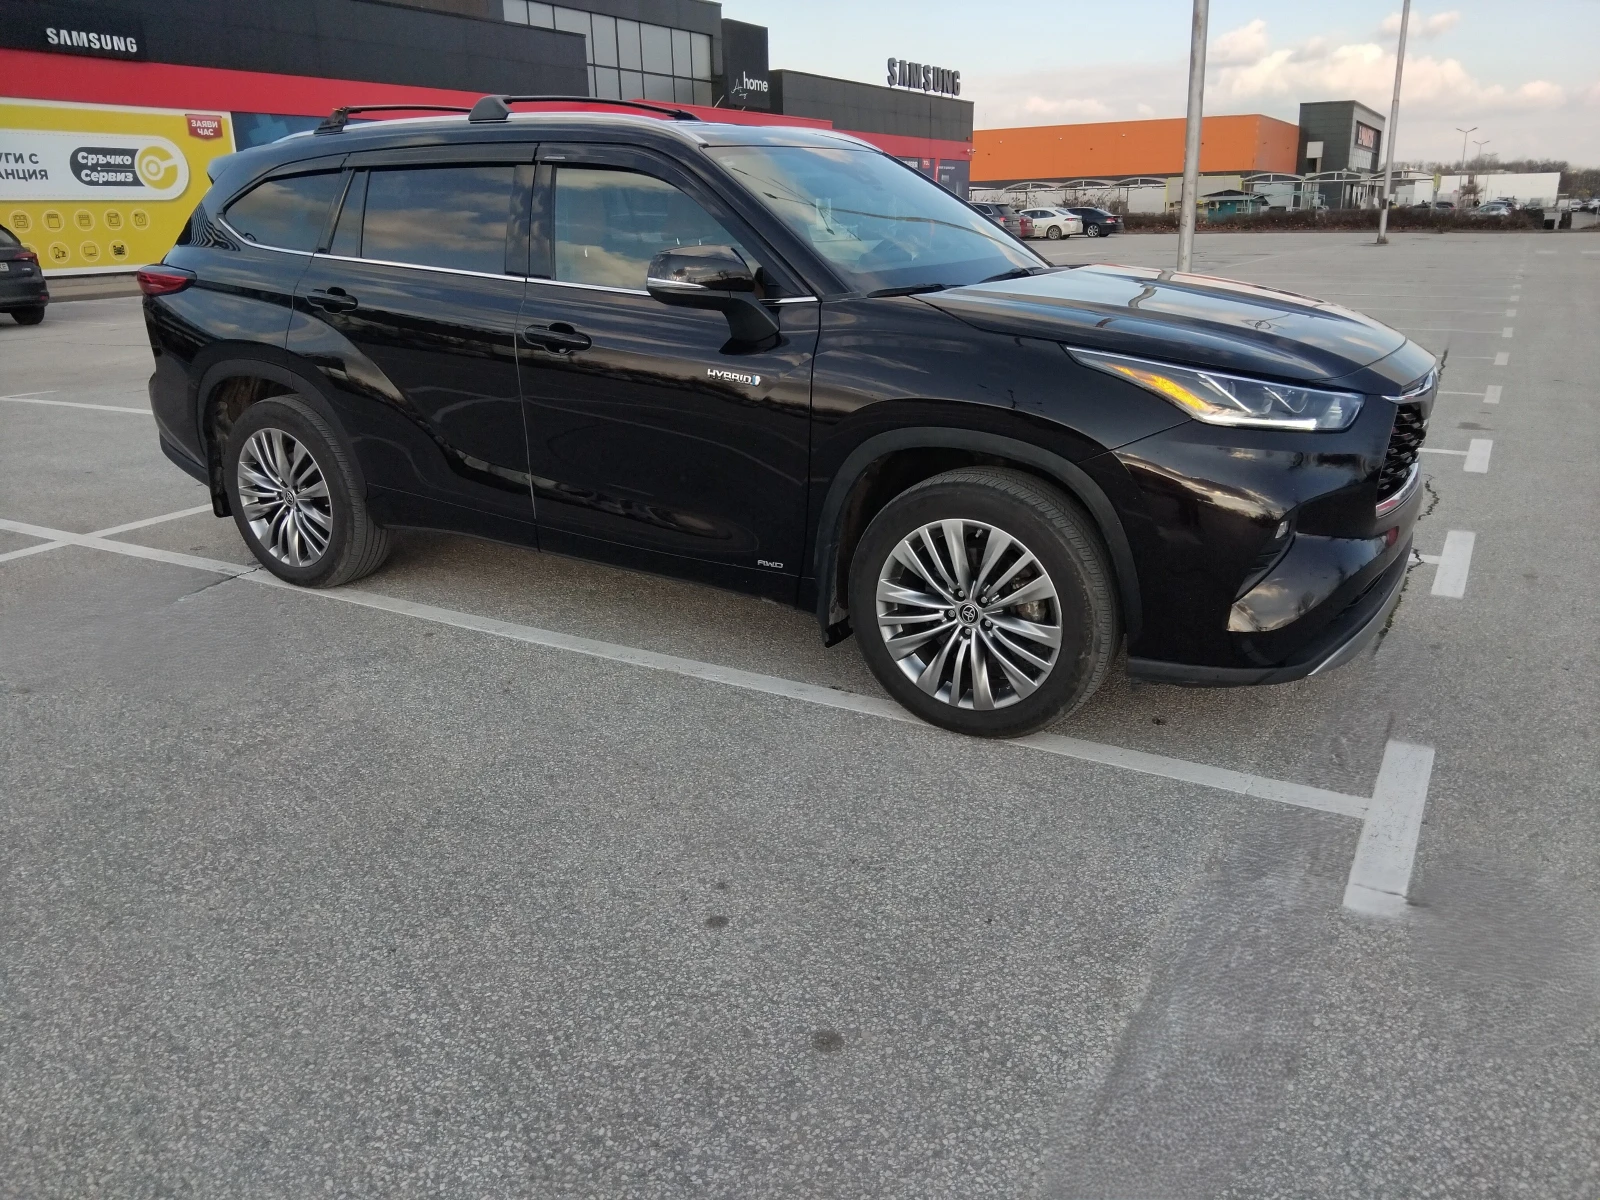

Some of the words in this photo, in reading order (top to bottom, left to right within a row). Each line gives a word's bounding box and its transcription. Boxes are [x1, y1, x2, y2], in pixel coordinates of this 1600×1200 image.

[46, 27, 138, 53] SAMSUNG
[743, 71, 769, 92] home
[887, 57, 961, 96] SAMSUNG
[191, 119, 218, 128] ЗАЯВИ
[197, 128, 214, 136] ЧАС
[77, 151, 132, 165] Сръчко
[81, 169, 133, 183] Сервиз
[707, 368, 752, 385] HYBRID
[757, 559, 784, 569] AWD
